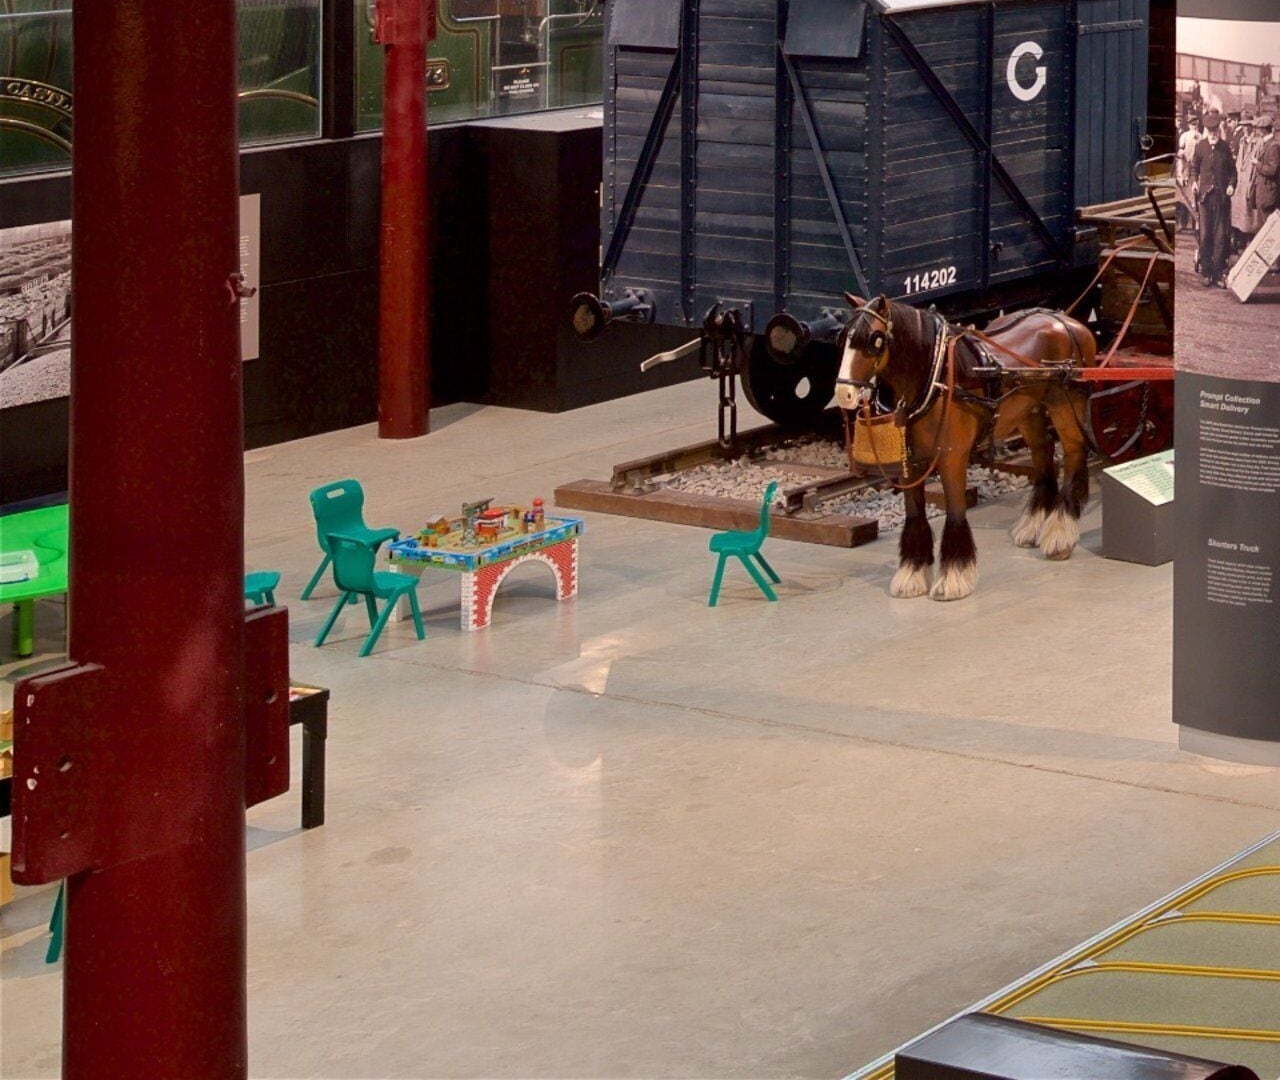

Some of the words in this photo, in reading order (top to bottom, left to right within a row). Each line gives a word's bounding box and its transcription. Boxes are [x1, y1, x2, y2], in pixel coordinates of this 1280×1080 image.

[1006, 41, 1047, 102] G
[7, 82, 73, 111] CASTL
[903, 266, 957, 295] 114202
